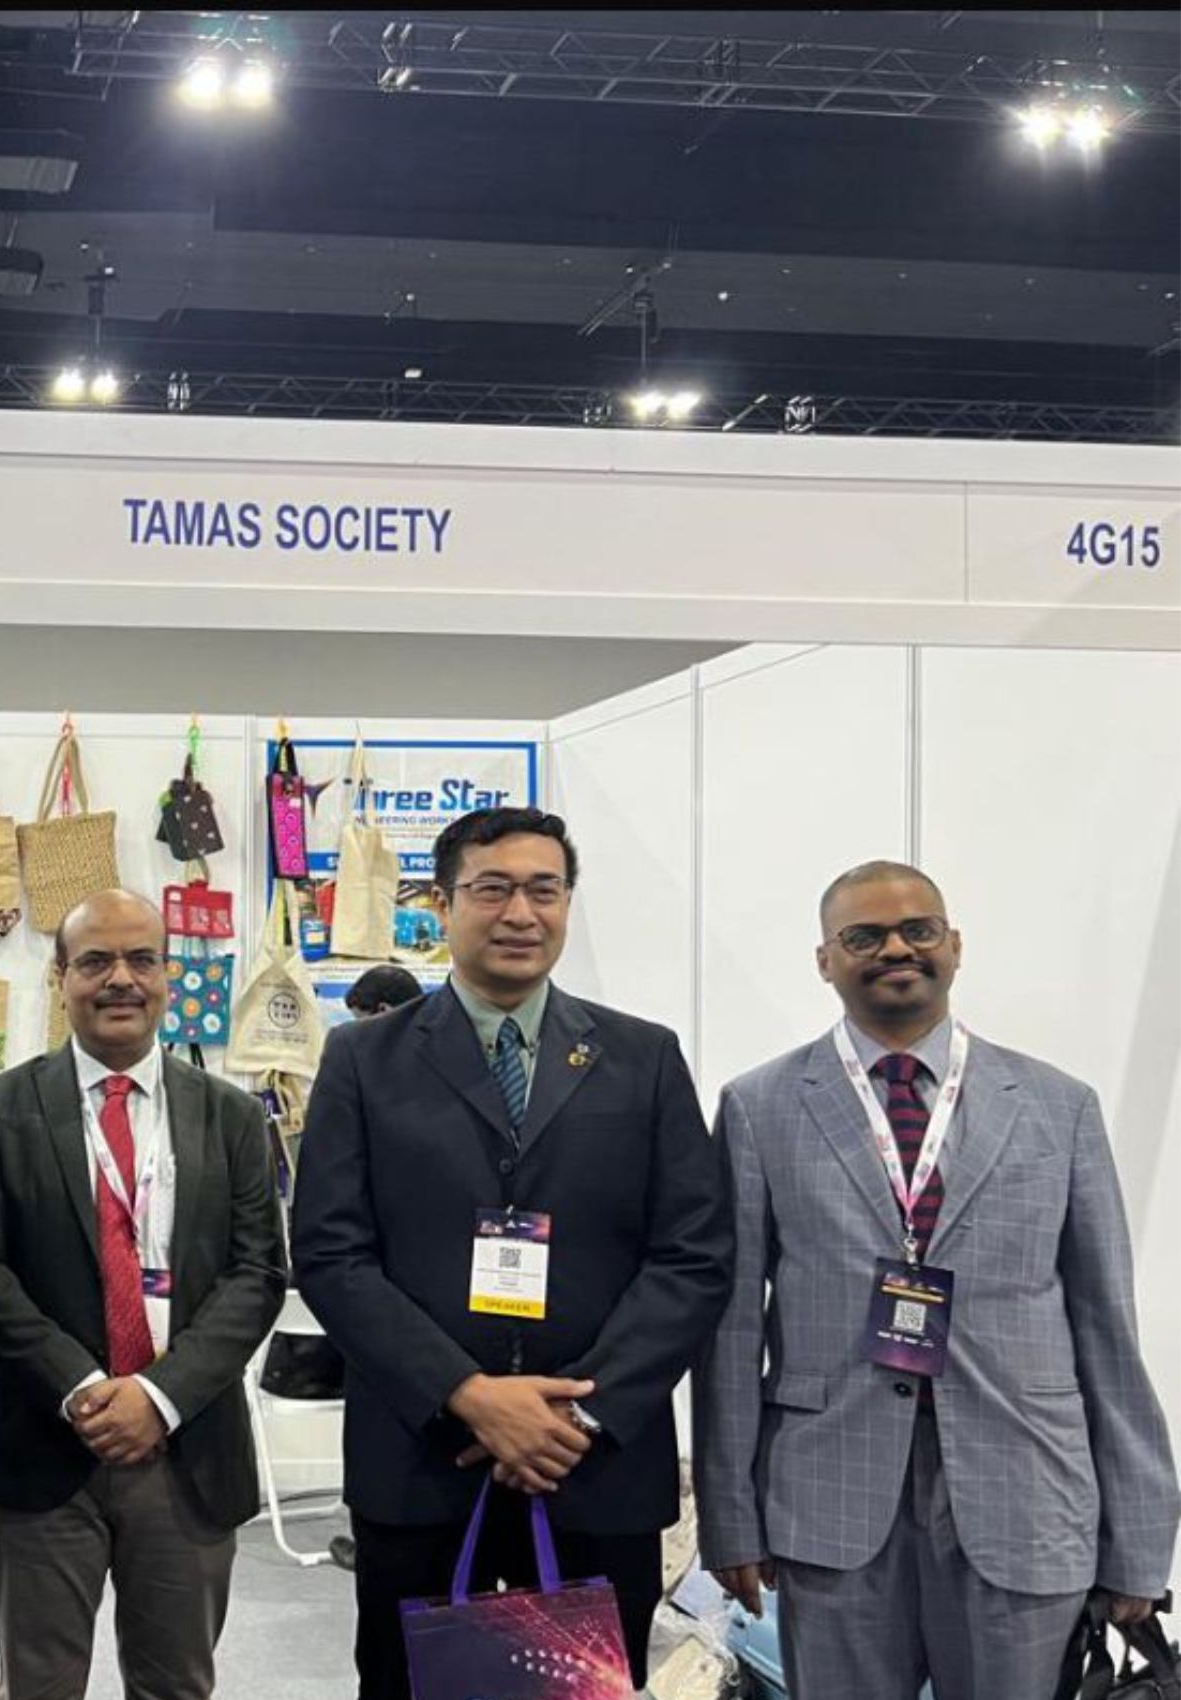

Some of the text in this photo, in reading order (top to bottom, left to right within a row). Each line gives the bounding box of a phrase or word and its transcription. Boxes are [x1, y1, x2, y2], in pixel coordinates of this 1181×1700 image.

[123, 499, 451, 553] TAMAS SOCIETY
[1066, 521, 1161, 568] 4G15
[439, 778, 510, 811] Star
